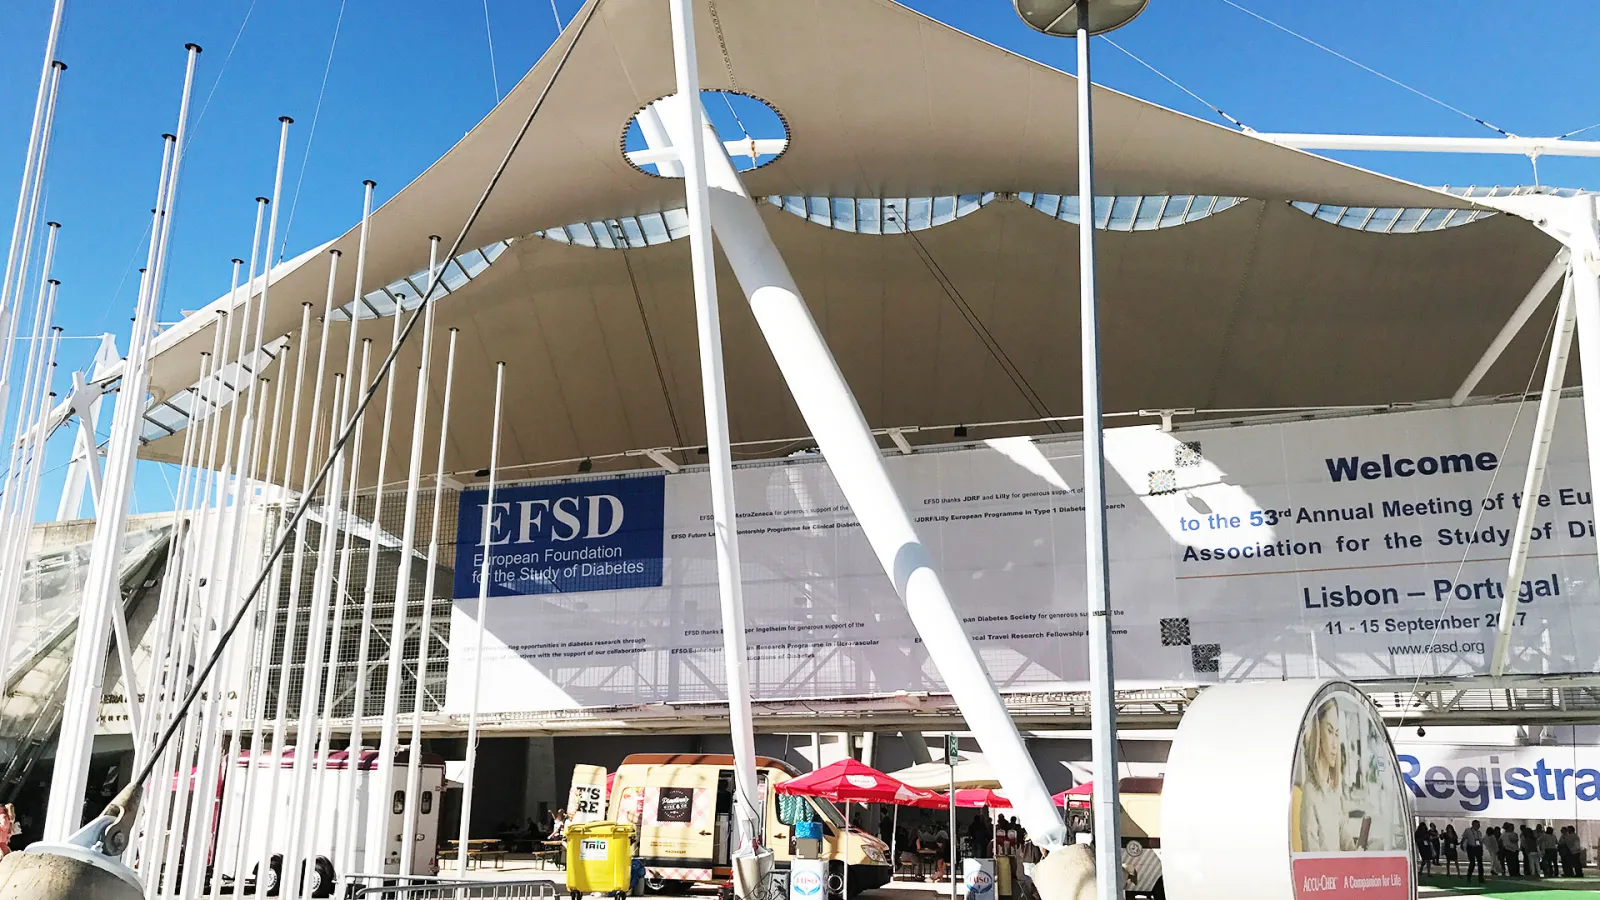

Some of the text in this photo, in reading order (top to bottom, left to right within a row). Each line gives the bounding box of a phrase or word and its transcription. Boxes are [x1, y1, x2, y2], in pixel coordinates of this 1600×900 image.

[1325, 451, 1498, 483] Welcome
[995, 492, 1009, 500] Lilly
[1022, 490, 1050, 499] generous
[1051, 488, 1076, 496] support
[950, 513, 982, 521] European
[984, 511, 1023, 519] Programme
[1033, 508, 1051, 516] Type
[1179, 517, 1200, 532] to
[1207, 513, 1241, 530] the
[1249, 508, 1292, 527] 53rd
[1296, 502, 1374, 524] Annual
[1382, 497, 1472, 518] Meeting
[1481, 493, 1504, 511] of
[1512, 491, 1551, 509] te
[475, 494, 624, 547] EFSD
[767, 525, 801, 534] Programme
[1183, 538, 1322, 563] Association
[1336, 535, 1370, 553] for
[1384, 531, 1422, 550] the
[1438, 525, 1511, 546] Study
[1530, 522, 1552, 540] of
[544, 545, 622, 563] Foundation
[494, 568, 515, 583] the
[519, 566, 560, 583] Study
[563, 563, 579, 578] of
[581, 560, 644, 576] Diabetes
[1304, 583, 1399, 609] Lisbon
[977, 614, 1008, 622] Diabetes
[1010, 613, 1037, 622] Society
[1038, 612, 1047, 620] for
[1049, 611, 1078, 620] generous
[1325, 620, 1342, 635] 11
[1360, 619, 1379, 634] 15
[1385, 615, 1480, 635] September
[1485, 611, 1527, 628] 27
[684, 629, 700, 637] EFSD
[700, 628, 719, 636] thanks
[755, 626, 787, 634] Ingelheim
[796, 624, 823, 632] generous
[824, 622, 847, 630] support
[847, 621, 855, 629] of
[988, 632, 1009, 640] Travel
[1011, 631, 1044, 639] Research
[1046, 629, 1083, 638] Fellowship
[520, 642, 559, 651] opportunities
[567, 640, 594, 648] diabetes
[622, 637, 646, 645] through
[1387, 641, 1485, 656] www.easd.org
[537, 651, 551, 659] with
[563, 650, 586, 659] support
[606, 647, 647, 655] collaborators
[1343, 875, 1349, 888] A
[1349, 875, 1382, 890] Companion
[1382, 875, 1390, 887] for
[1390, 874, 1401, 886] Life
